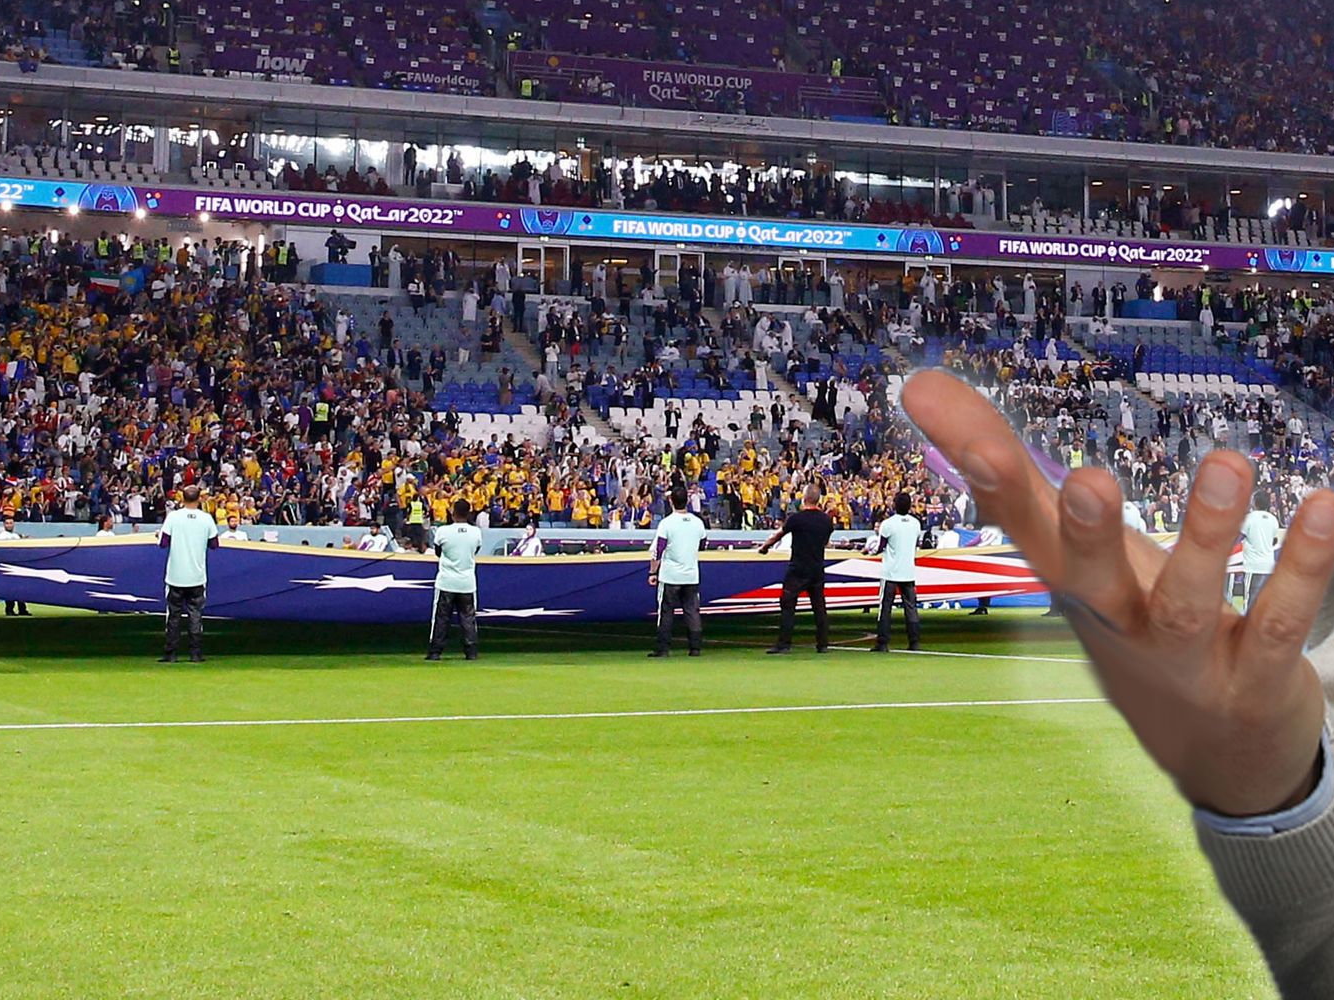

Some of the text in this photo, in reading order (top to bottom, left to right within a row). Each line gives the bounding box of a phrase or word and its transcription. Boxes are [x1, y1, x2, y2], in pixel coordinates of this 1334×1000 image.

[255, 54, 308, 73] now
[383, 70, 480, 88] #FAWorldCup
[643, 70, 752, 89] FIFA WORLD CUP
[978, 114, 1018, 126] Stadium
[195, 196, 235, 212] FIFA
[235, 198, 295, 216] WORLD
[298, 201, 331, 218] CUP
[613, 219, 646, 235] FIFA
[647, 221, 702, 238] WORLD
[704, 223, 734, 239] CUP
[999, 240, 1030, 254] FIFA
[1030, 241, 1079, 256] WORLD
[1080, 243, 1107, 258] CUP
